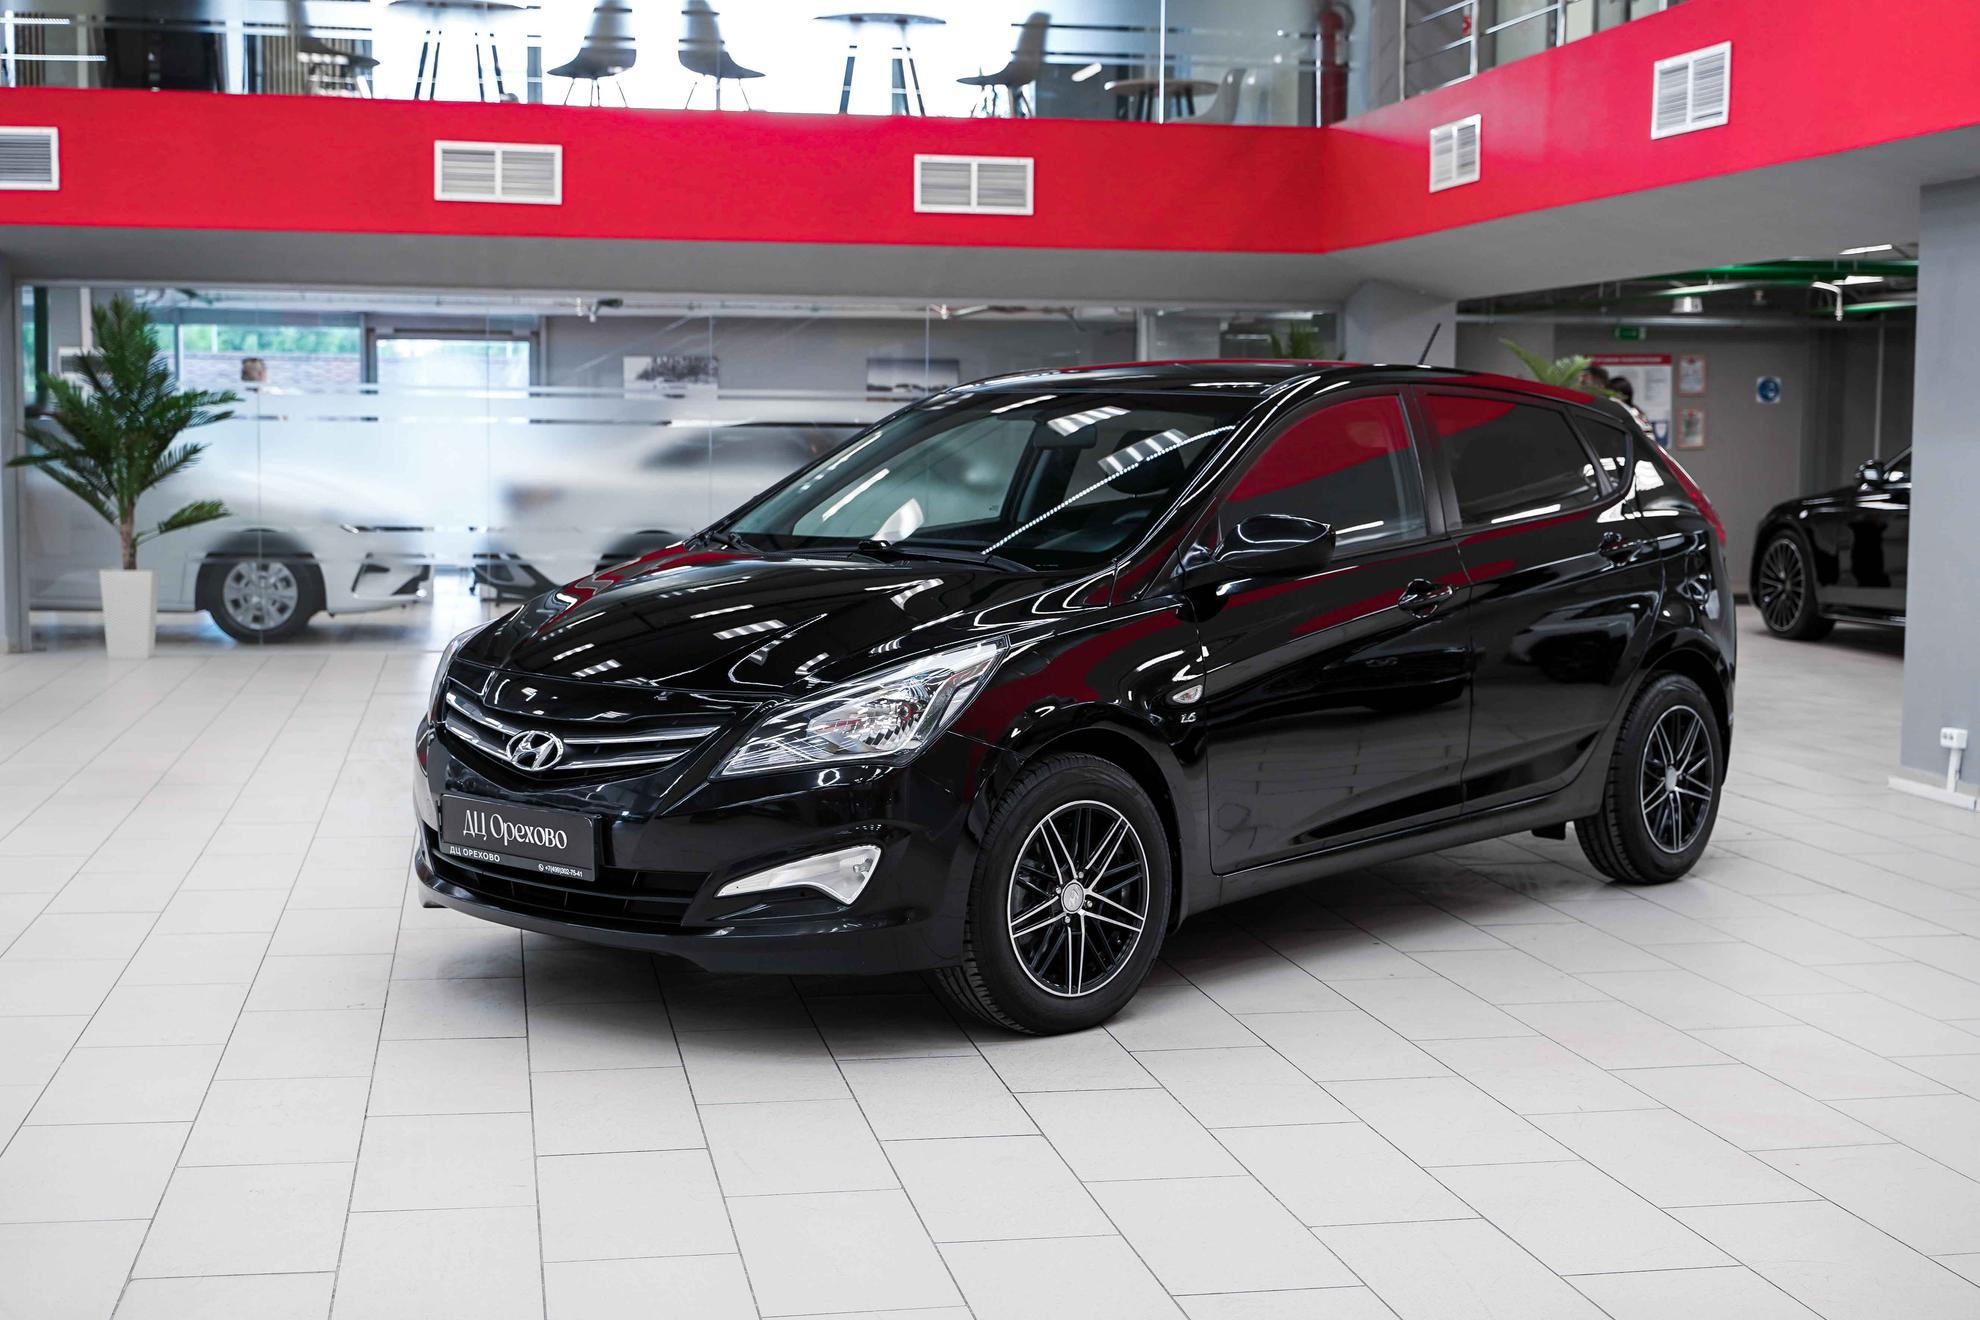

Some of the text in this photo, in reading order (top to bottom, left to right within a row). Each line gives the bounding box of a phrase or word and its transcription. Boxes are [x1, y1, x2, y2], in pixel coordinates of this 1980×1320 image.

[463, 809, 567, 849] ДЦ Орехово
[449, 846, 501, 863] ДЦ ОРЕХОВО
